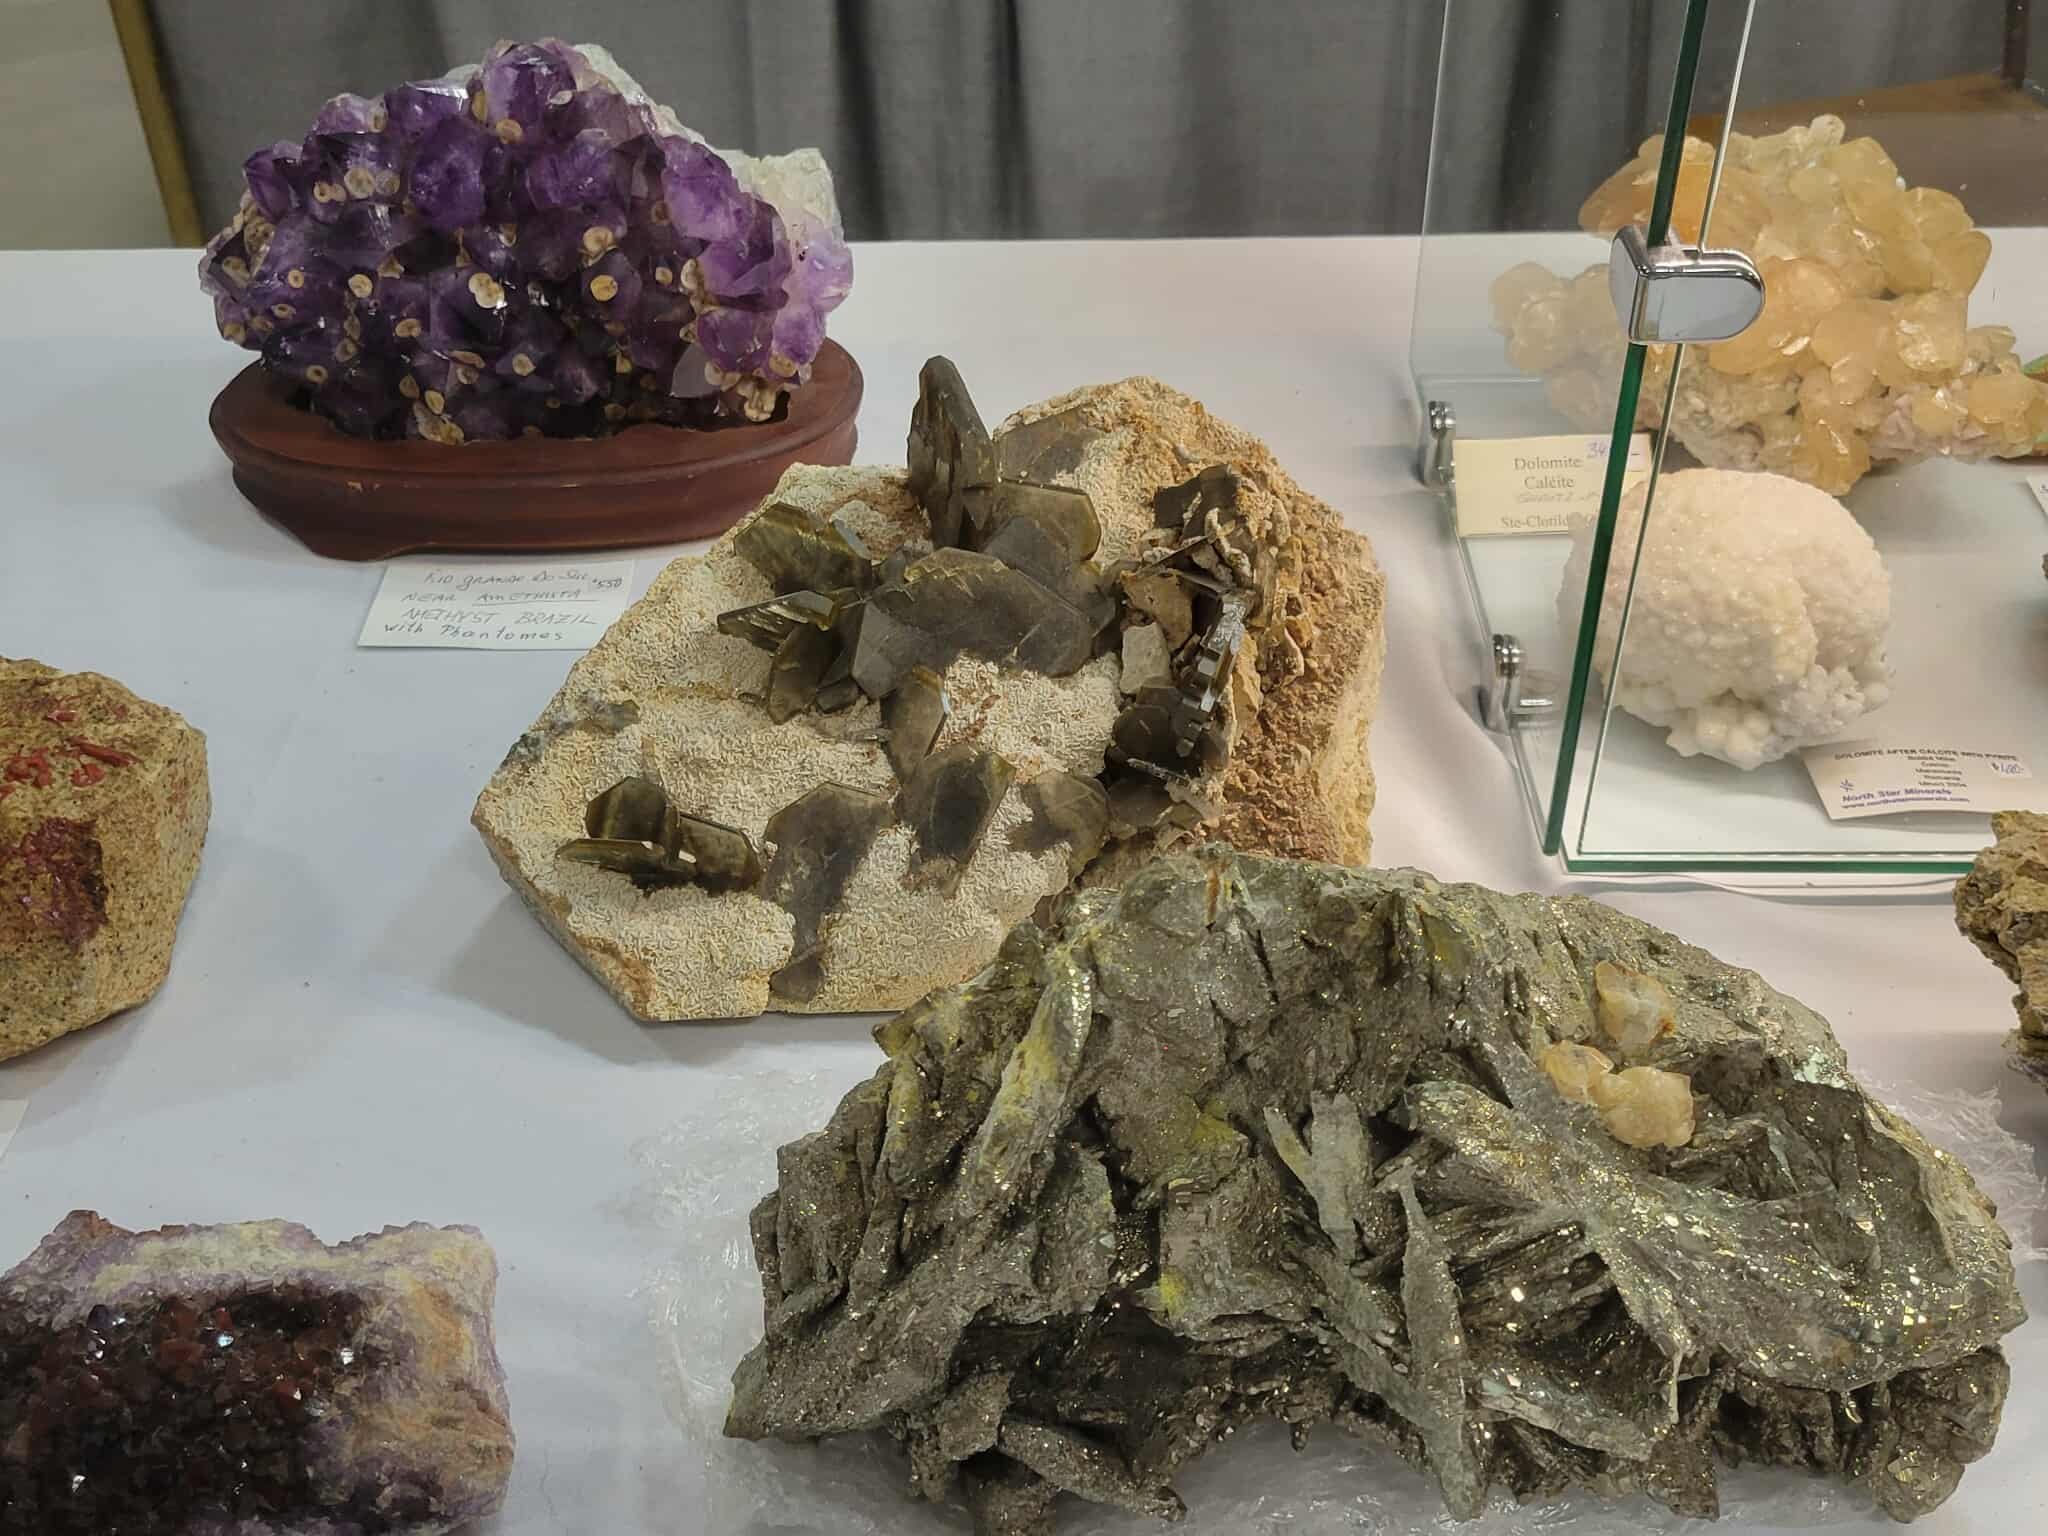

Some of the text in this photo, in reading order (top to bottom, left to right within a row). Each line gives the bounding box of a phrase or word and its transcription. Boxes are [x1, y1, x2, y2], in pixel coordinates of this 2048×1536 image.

[1513, 457, 1584, 471] Dolomite
[1501, 514, 1570, 529] Ste-Clotild
[400, 592, 456, 602] NEAR
[514, 611, 598, 625] BRAZIL
[384, 621, 423, 633] with
[1834, 749, 1884, 760] DOLOMITE
[1919, 749, 1958, 757] CALCITE
[1841, 793, 1875, 802] North
[1877, 790, 1901, 798] Star
